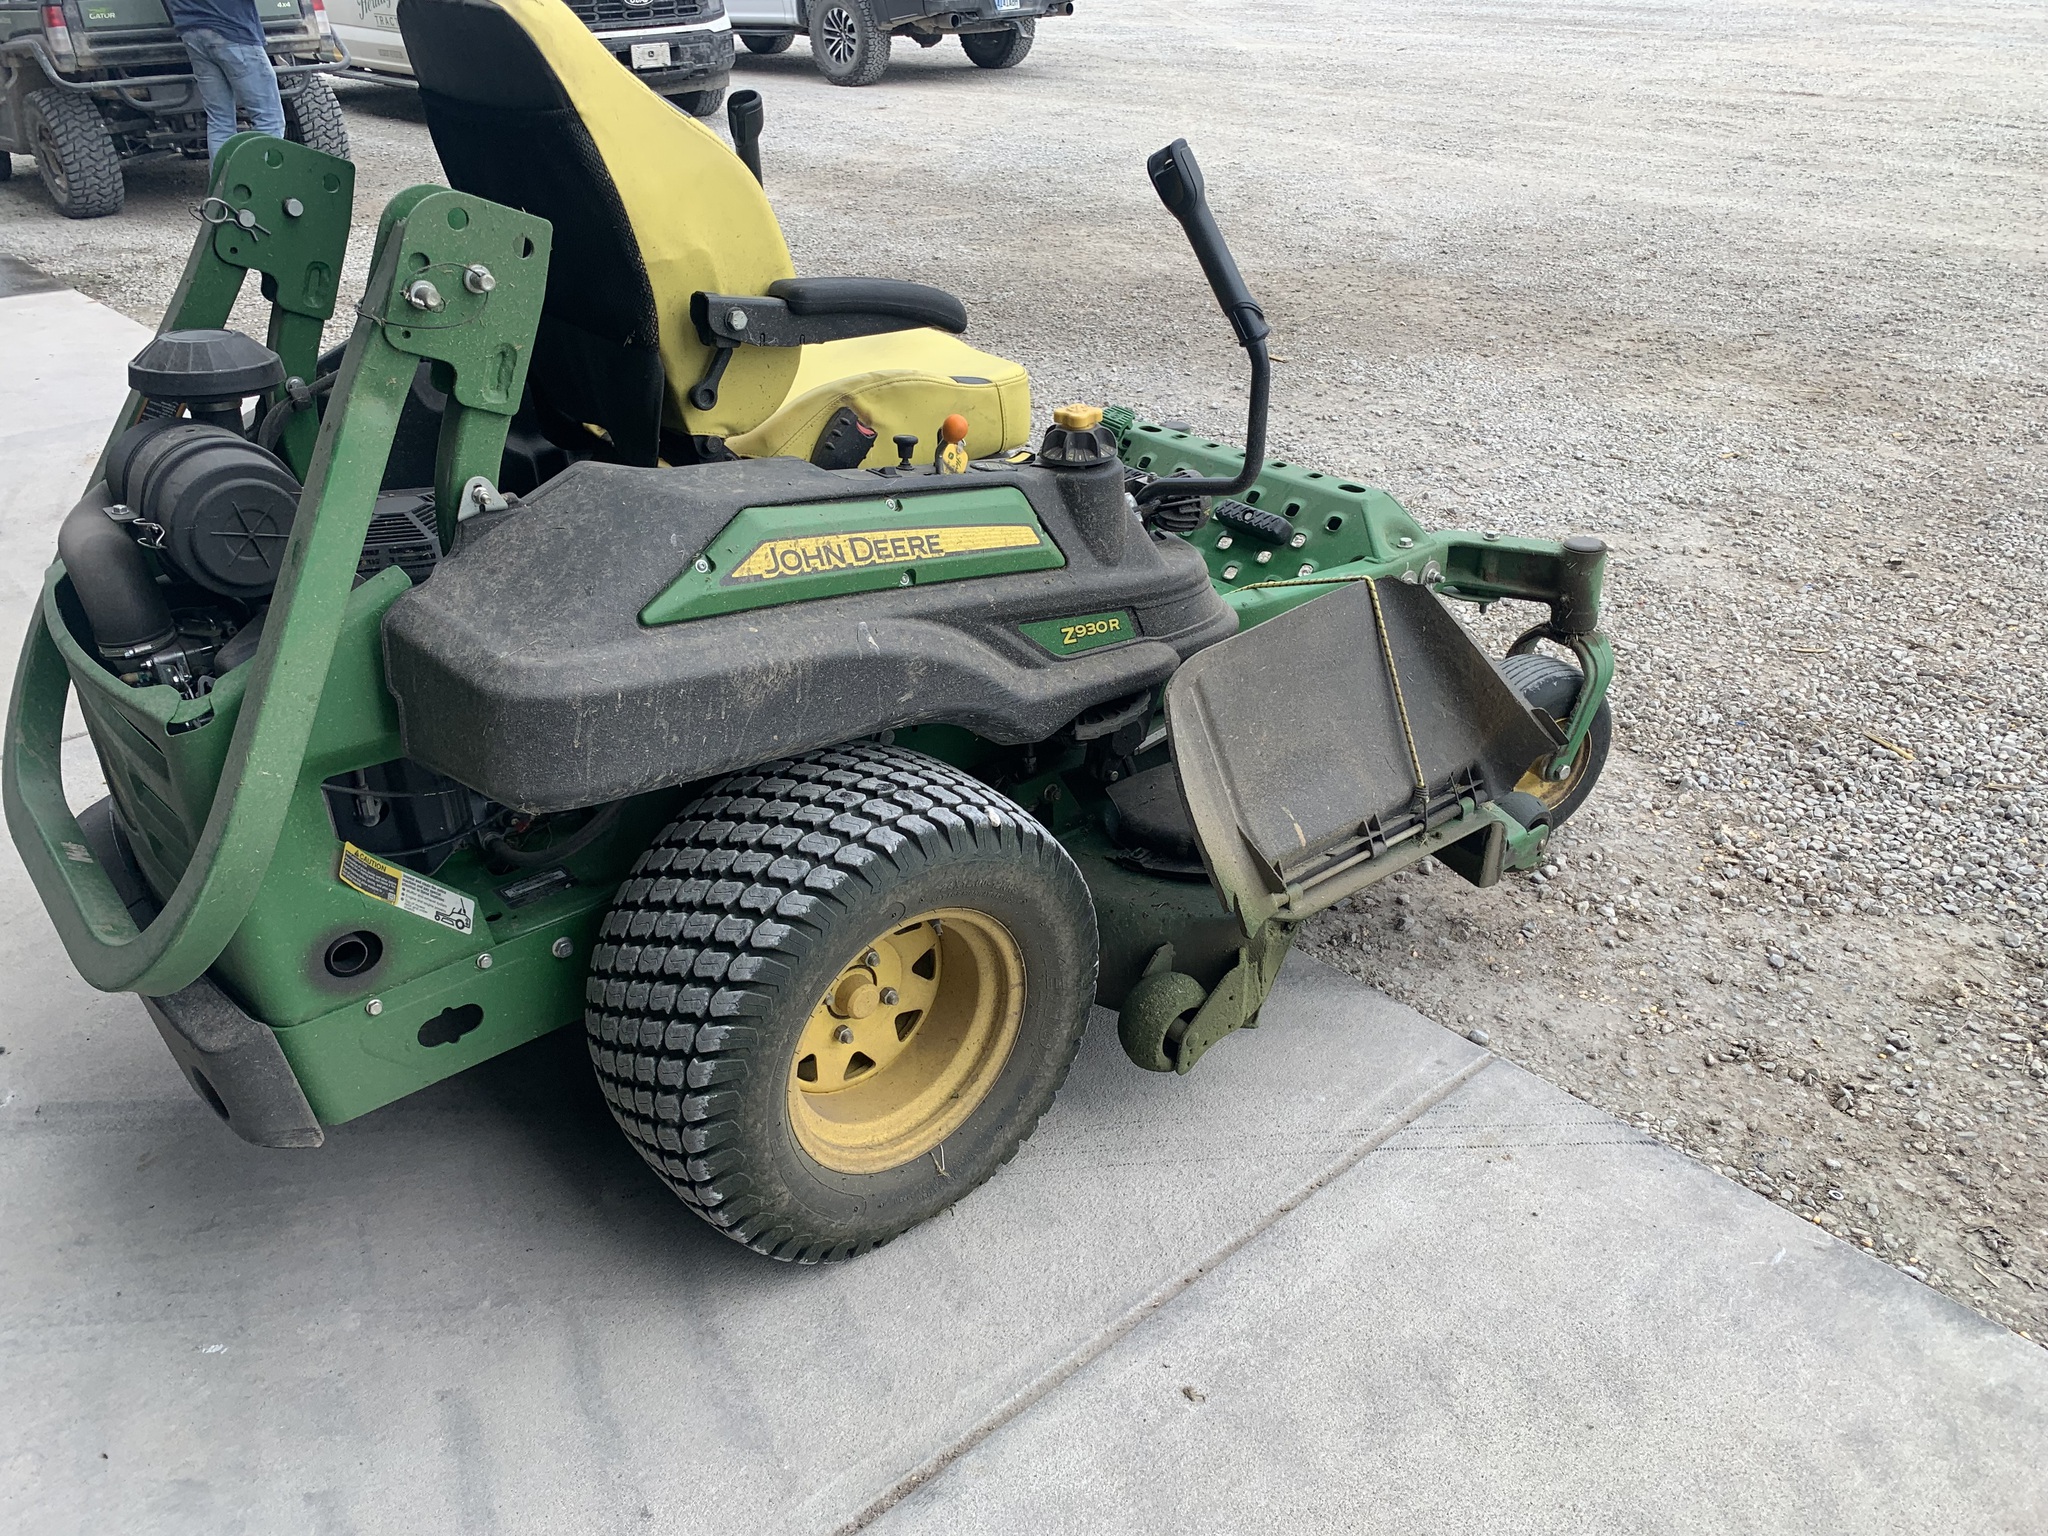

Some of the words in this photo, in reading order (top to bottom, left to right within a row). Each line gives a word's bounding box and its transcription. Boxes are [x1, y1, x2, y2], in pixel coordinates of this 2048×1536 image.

[89, 12, 115, 20] GATOR
[765, 543, 846, 574] JOHN
[848, 534, 944, 562] DEERE
[1061, 618, 1120, 645] Z930R
[360, 853, 387, 872] CAUTION
